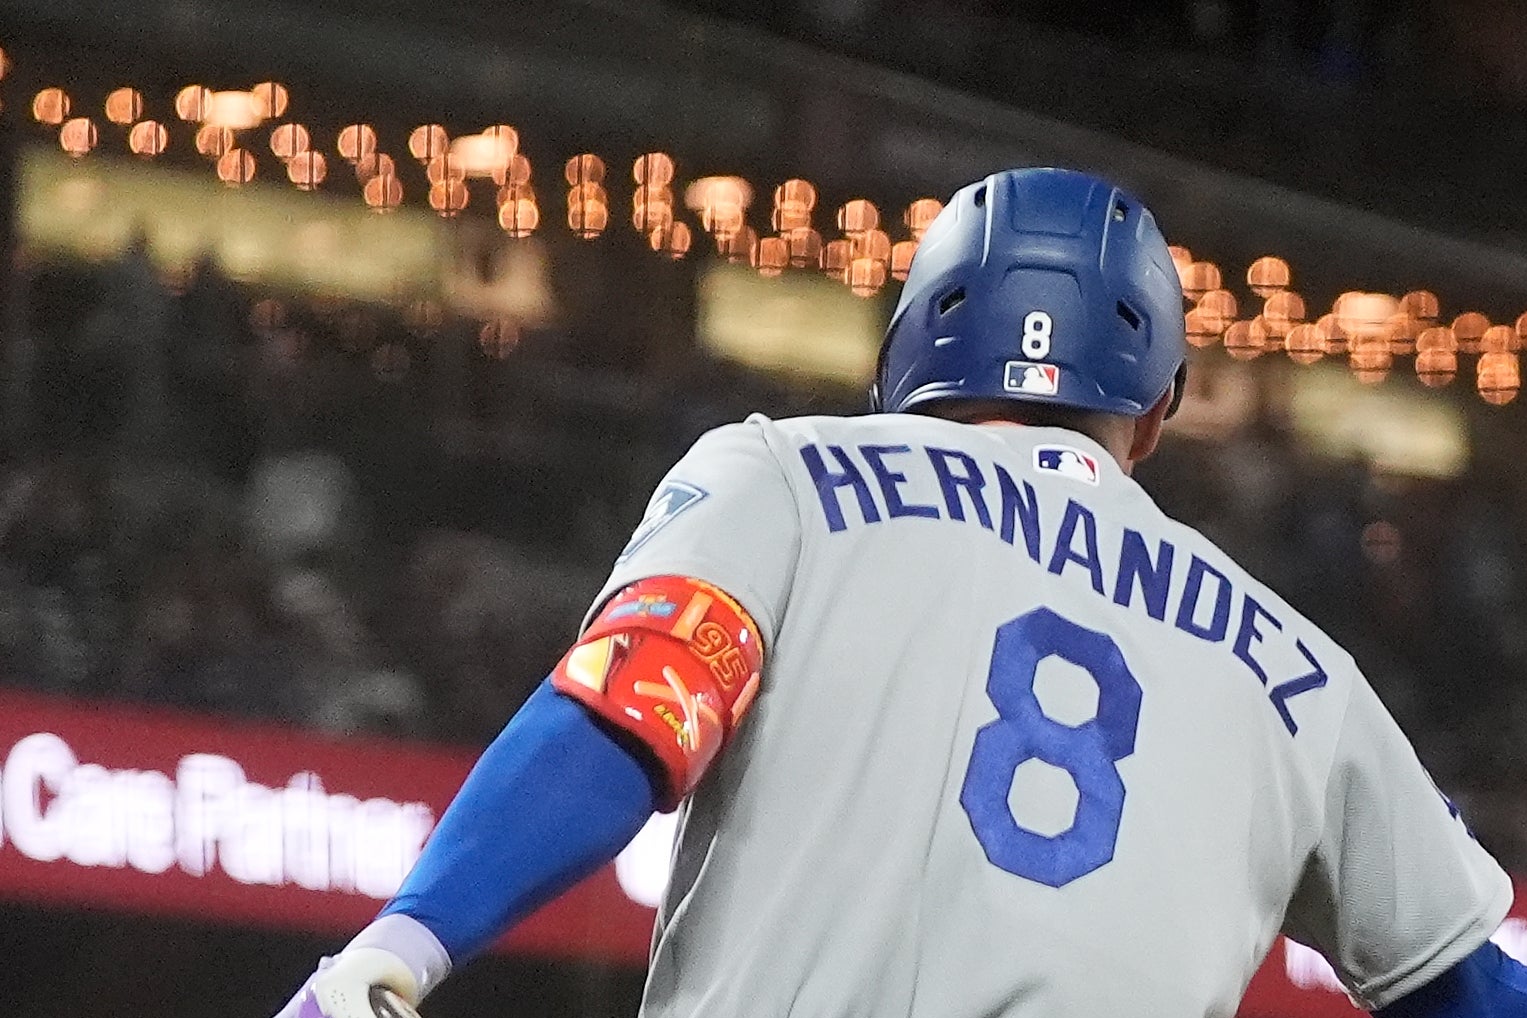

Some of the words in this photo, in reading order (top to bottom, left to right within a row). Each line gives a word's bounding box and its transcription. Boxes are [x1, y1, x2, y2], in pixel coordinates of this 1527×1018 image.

[1022, 310, 1053, 360] 8
[688, 621, 749, 691] 95
[800, 443, 1328, 737] HERNANDEZ
[959, 606, 1143, 888] 8
